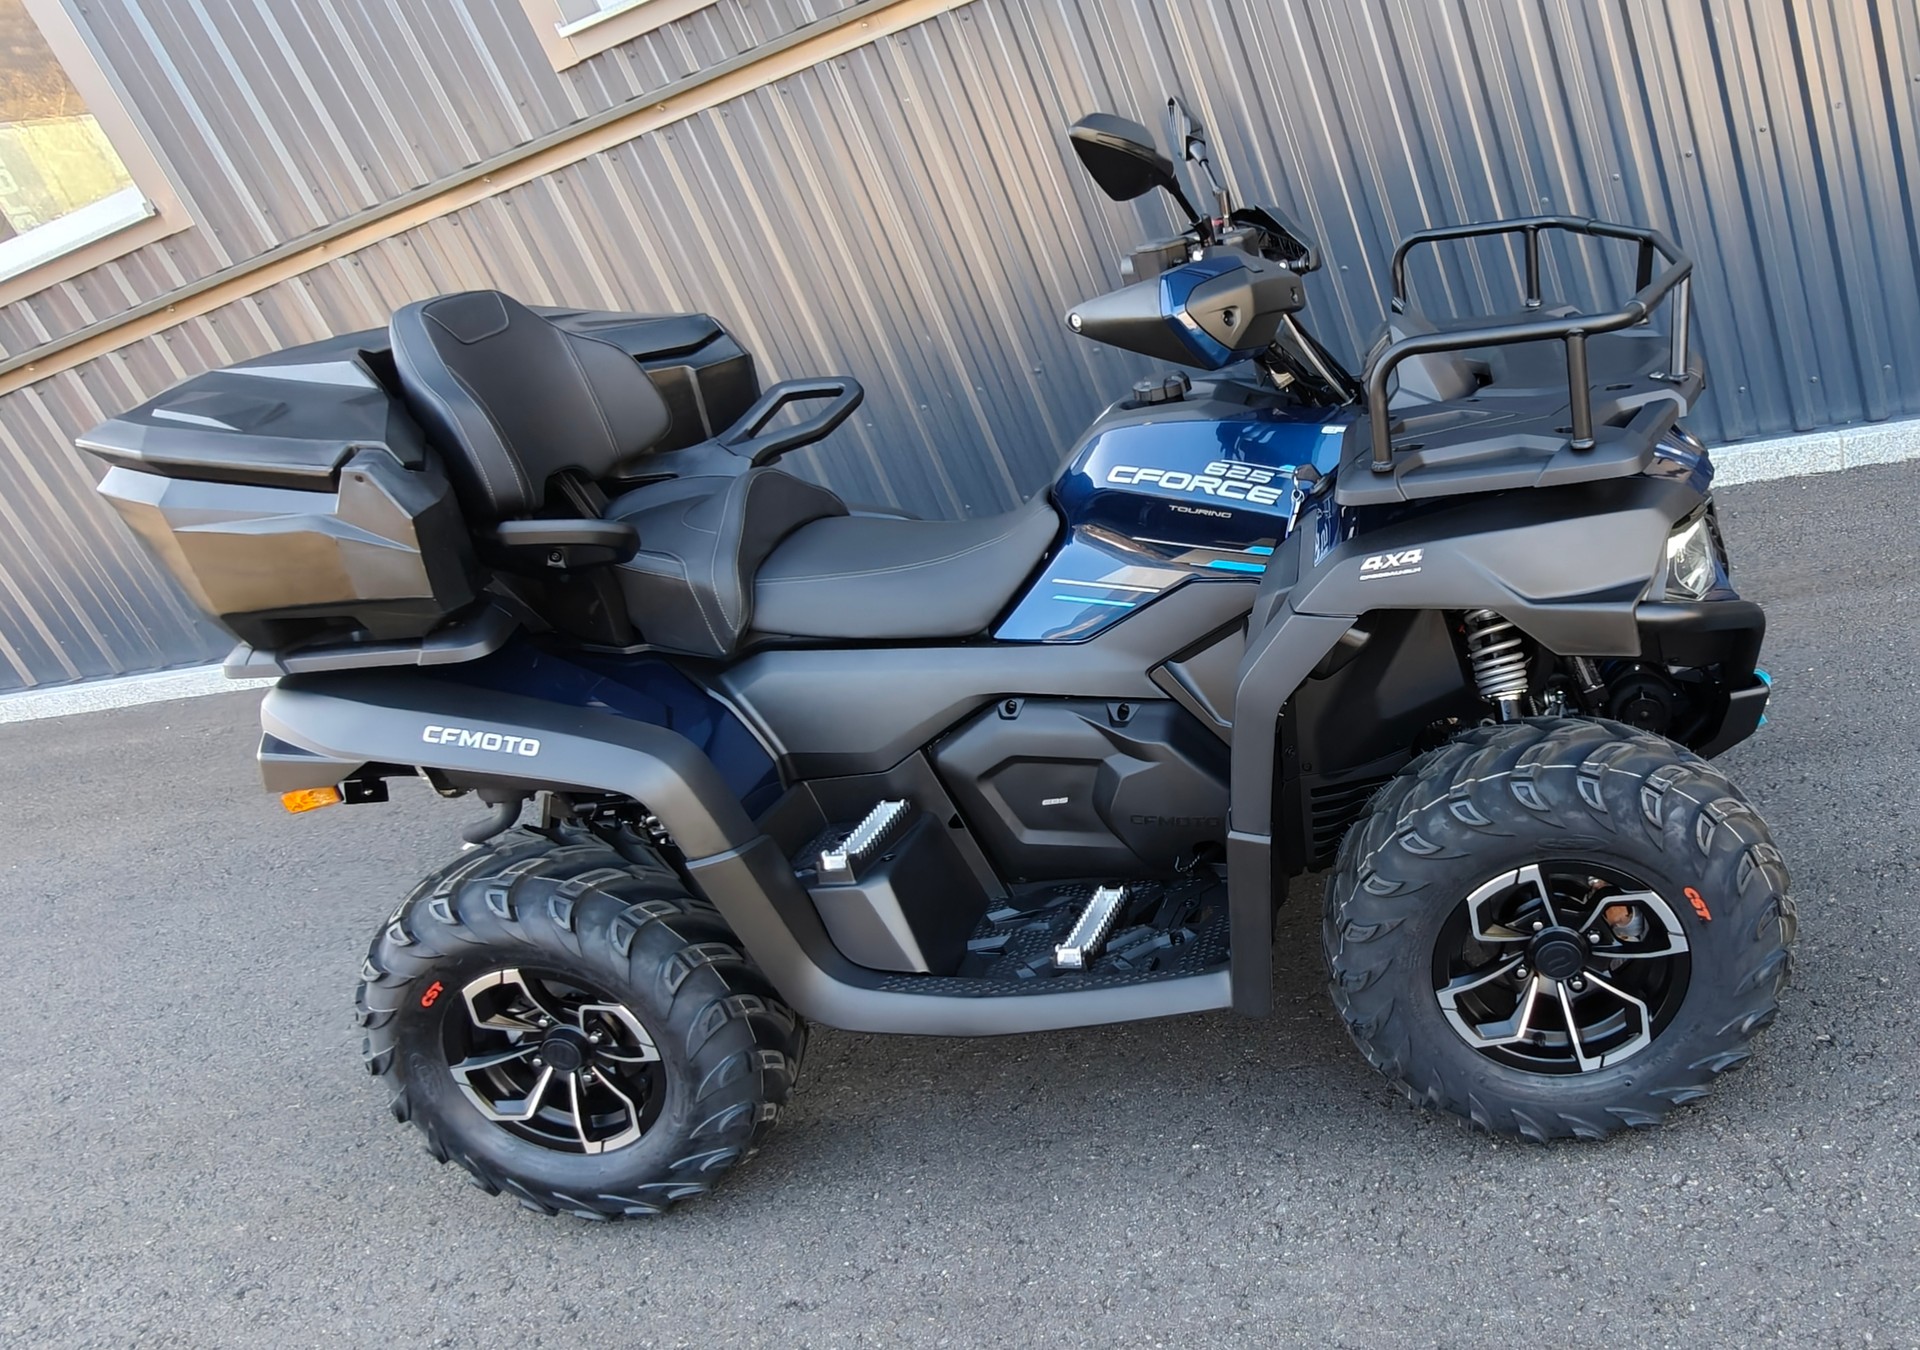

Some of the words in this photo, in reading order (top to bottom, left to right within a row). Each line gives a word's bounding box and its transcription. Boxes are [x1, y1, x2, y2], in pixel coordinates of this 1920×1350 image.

[1107, 466, 1283, 505] CFORCE
[1204, 462, 1274, 484] 625
[1168, 505, 1232, 519] TOURING
[422, 726, 540, 757] CFMOTO
[1130, 815, 1221, 828] CFMOTO
[1684, 887, 1712, 921] CST
[421, 981, 443, 1007] CST
